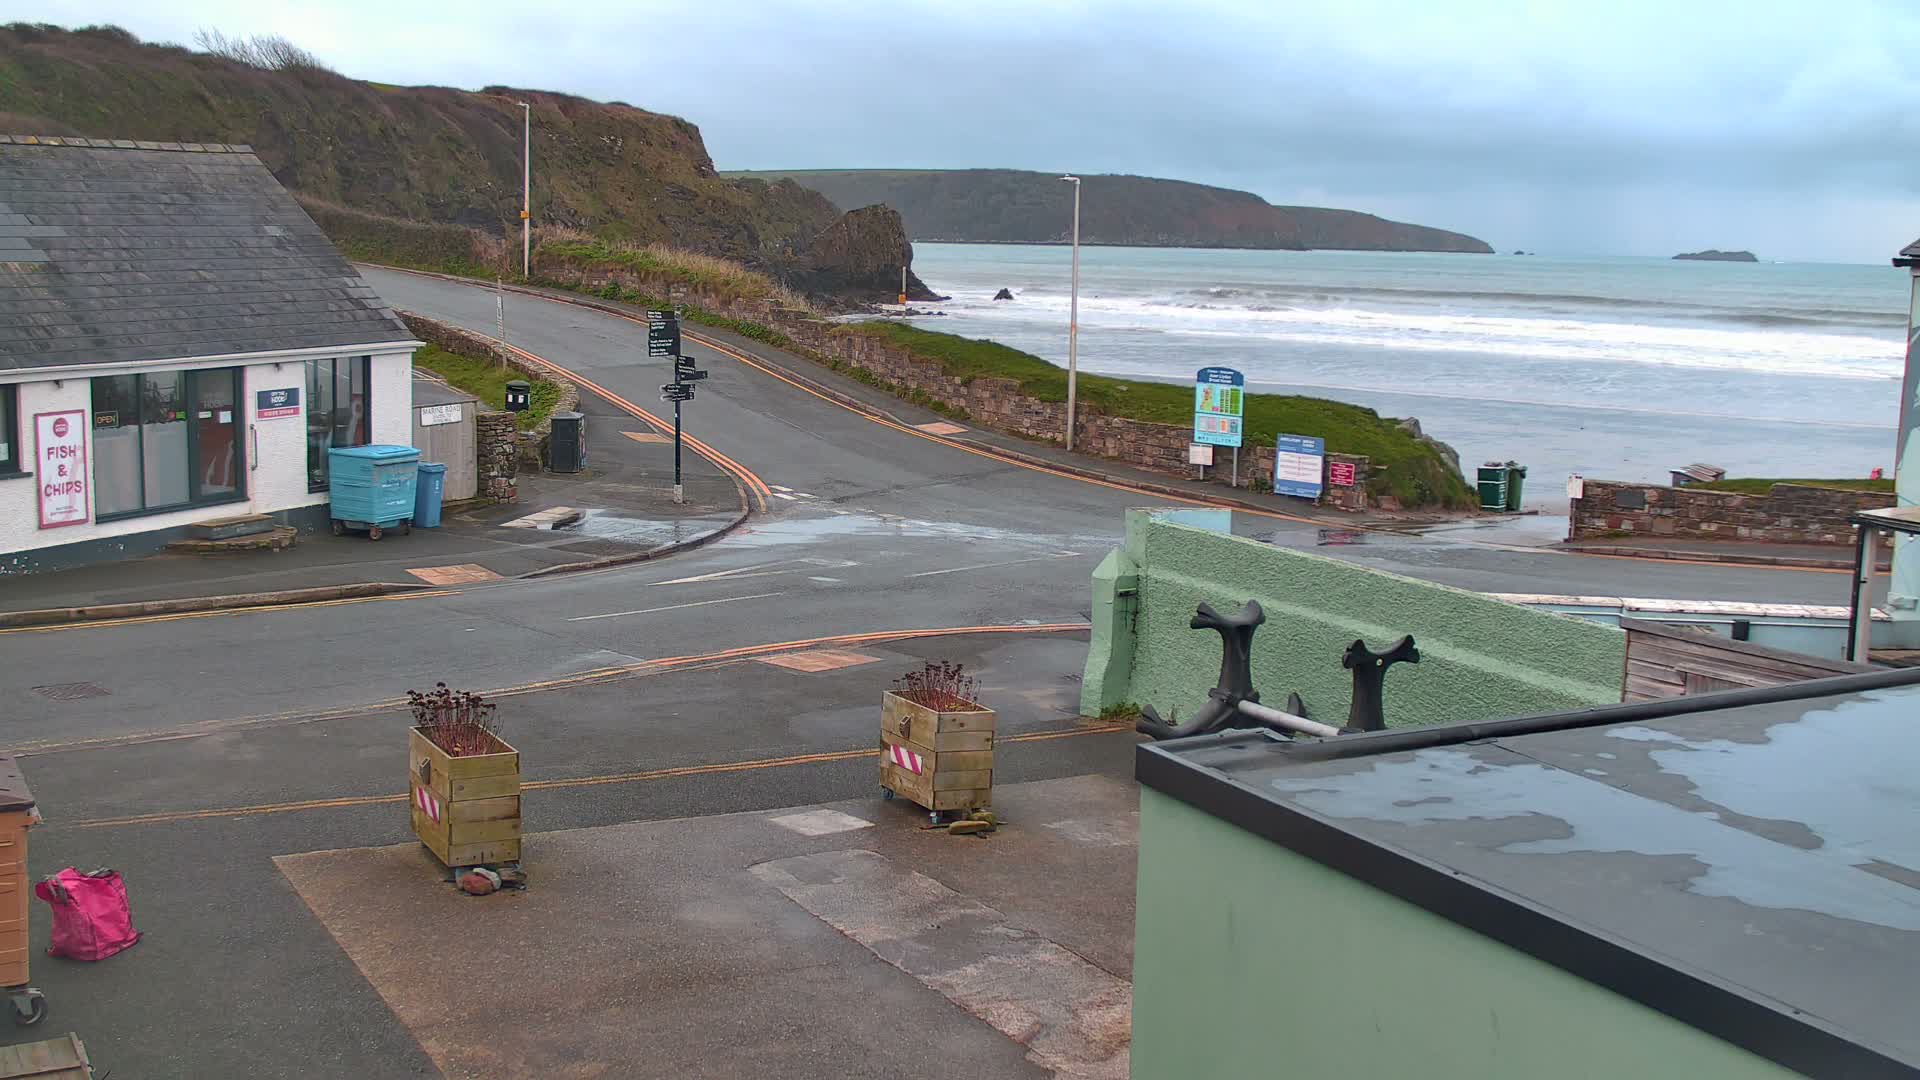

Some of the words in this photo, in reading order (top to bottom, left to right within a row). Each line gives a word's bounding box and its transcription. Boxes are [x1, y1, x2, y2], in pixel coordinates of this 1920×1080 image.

[422, 406, 444, 415] MARINE
[445, 404, 461, 412] ROAD
[96, 415, 117, 424] OPEN
[47, 444, 77, 460] FISH
[57, 464, 68, 477] &
[44, 480, 82, 497] CHIPS
